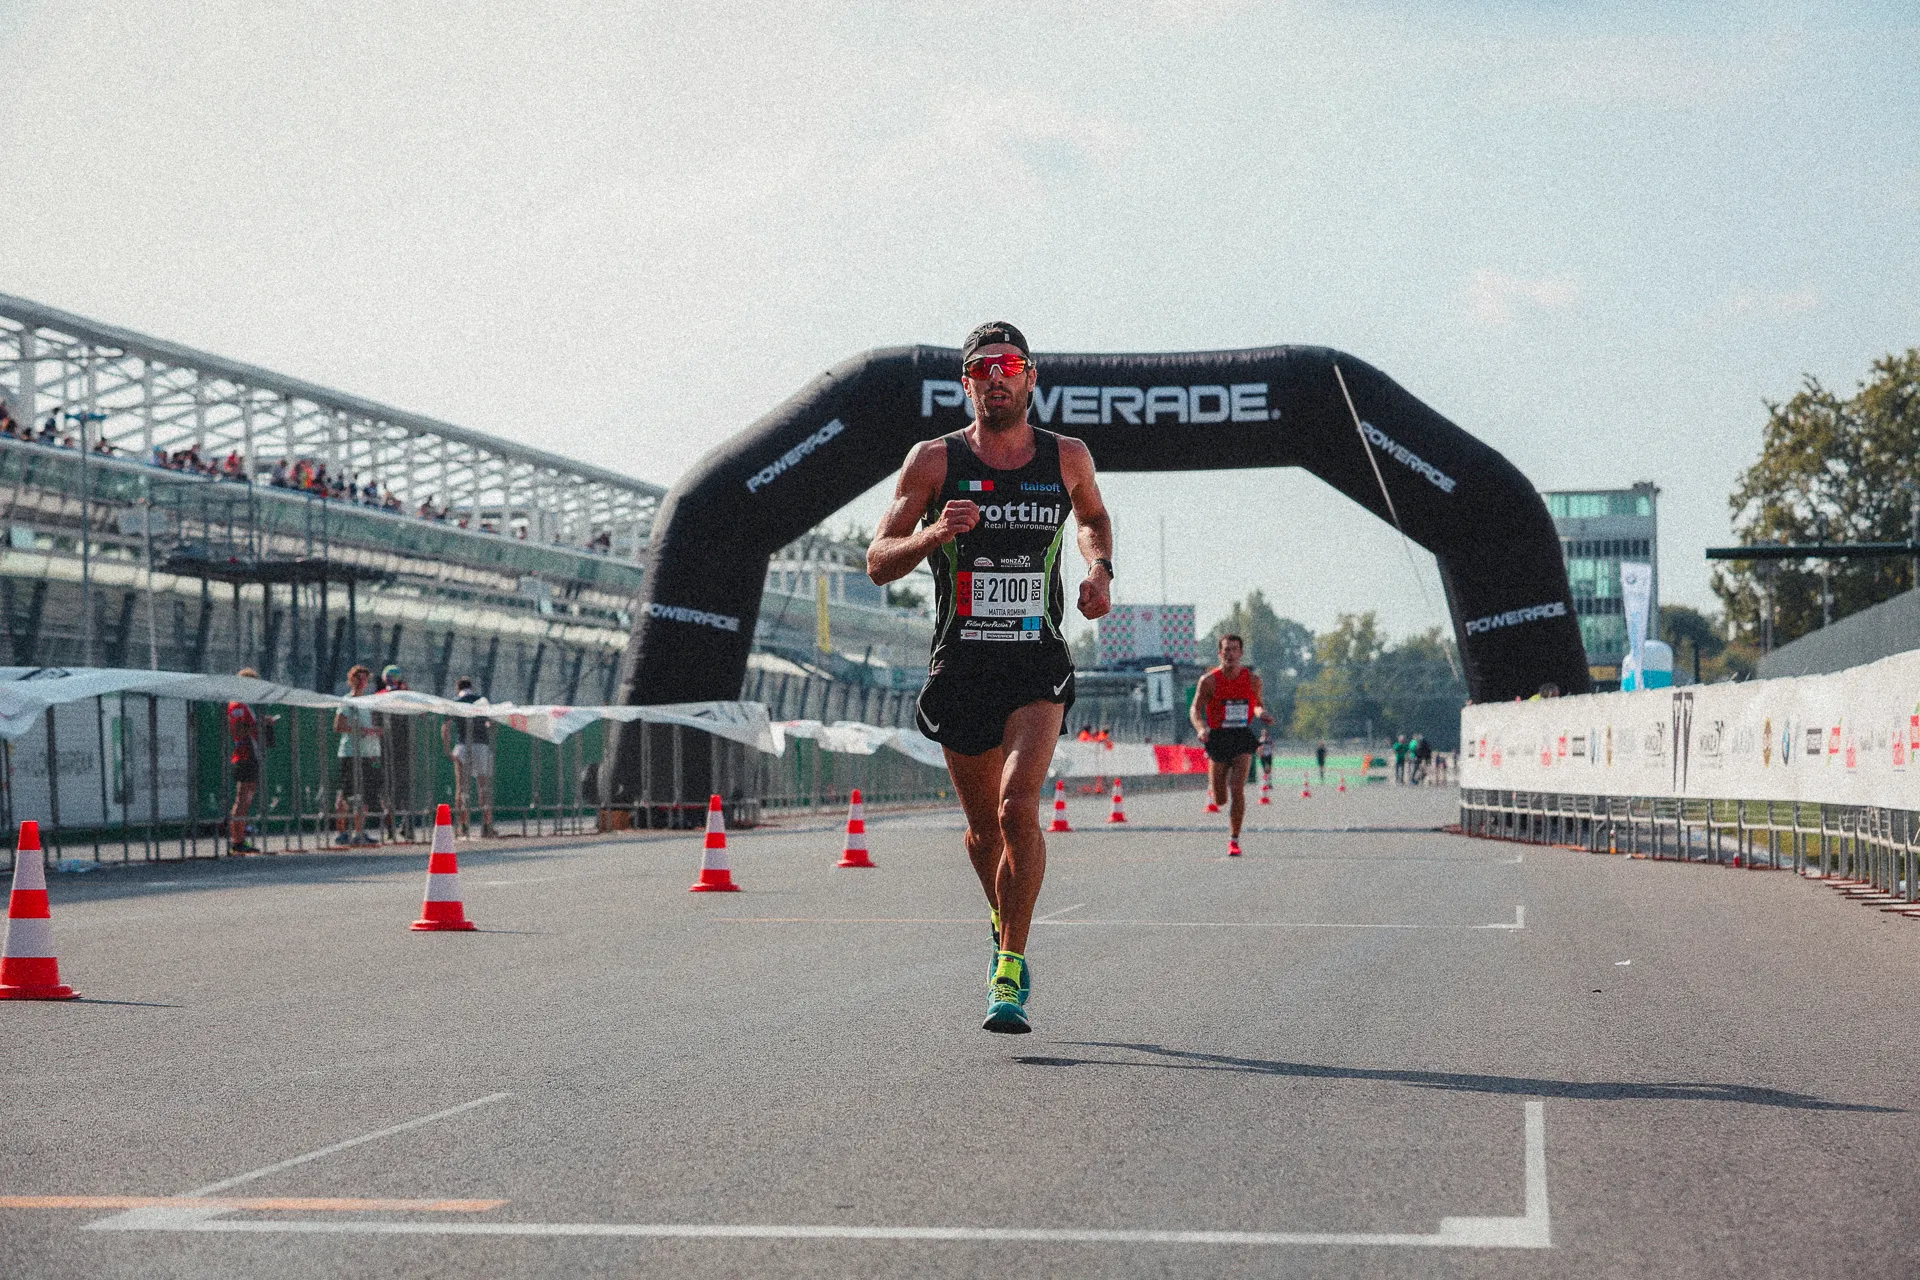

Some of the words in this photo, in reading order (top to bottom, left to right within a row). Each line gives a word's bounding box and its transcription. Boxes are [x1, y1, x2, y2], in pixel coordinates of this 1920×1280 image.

[921, 379, 1269, 424] PWERADE
[746, 418, 845, 493] POWERADE
[1356, 421, 1457, 494] POWERADE
[984, 521, 1007, 530] Retail
[1009, 521, 1058, 532] Environments
[988, 577, 1028, 603] 2100
[988, 608, 1006, 616] MATTIA
[1465, 601, 1567, 637] POWERADE
